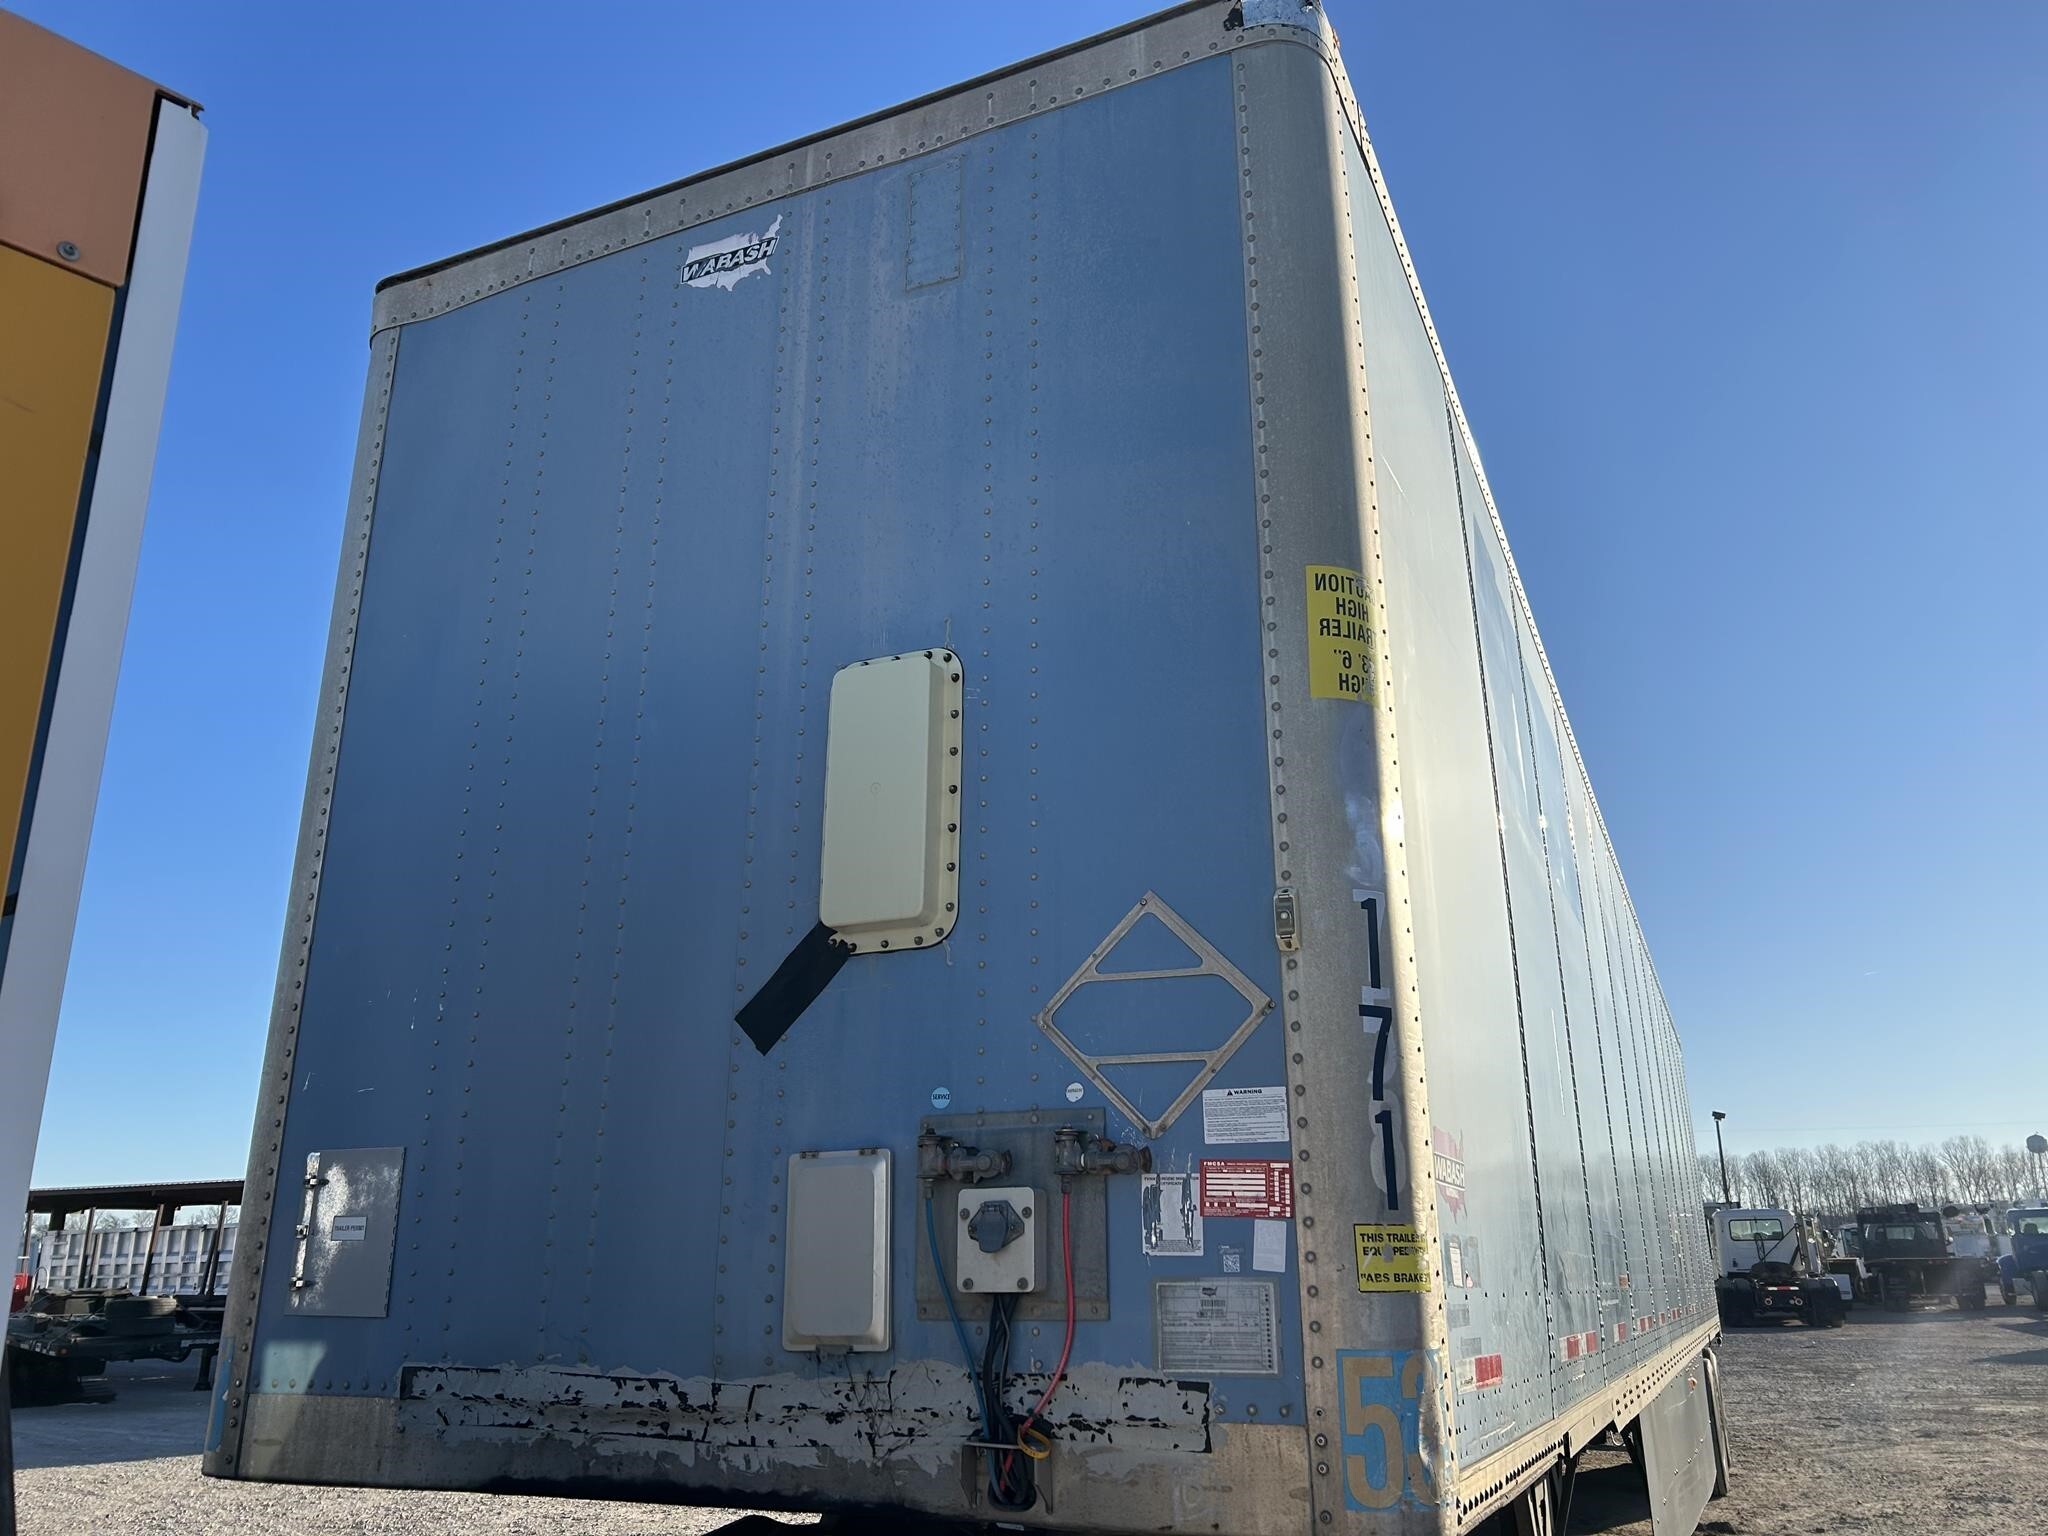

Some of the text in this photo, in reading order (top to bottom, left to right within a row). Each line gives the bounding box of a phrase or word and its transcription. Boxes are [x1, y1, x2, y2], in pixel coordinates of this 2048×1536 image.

[682, 239, 776, 282] WABASH
[1434, 1155, 1465, 1186] WABASH
[1359, 1233, 1384, 1243] THIS
